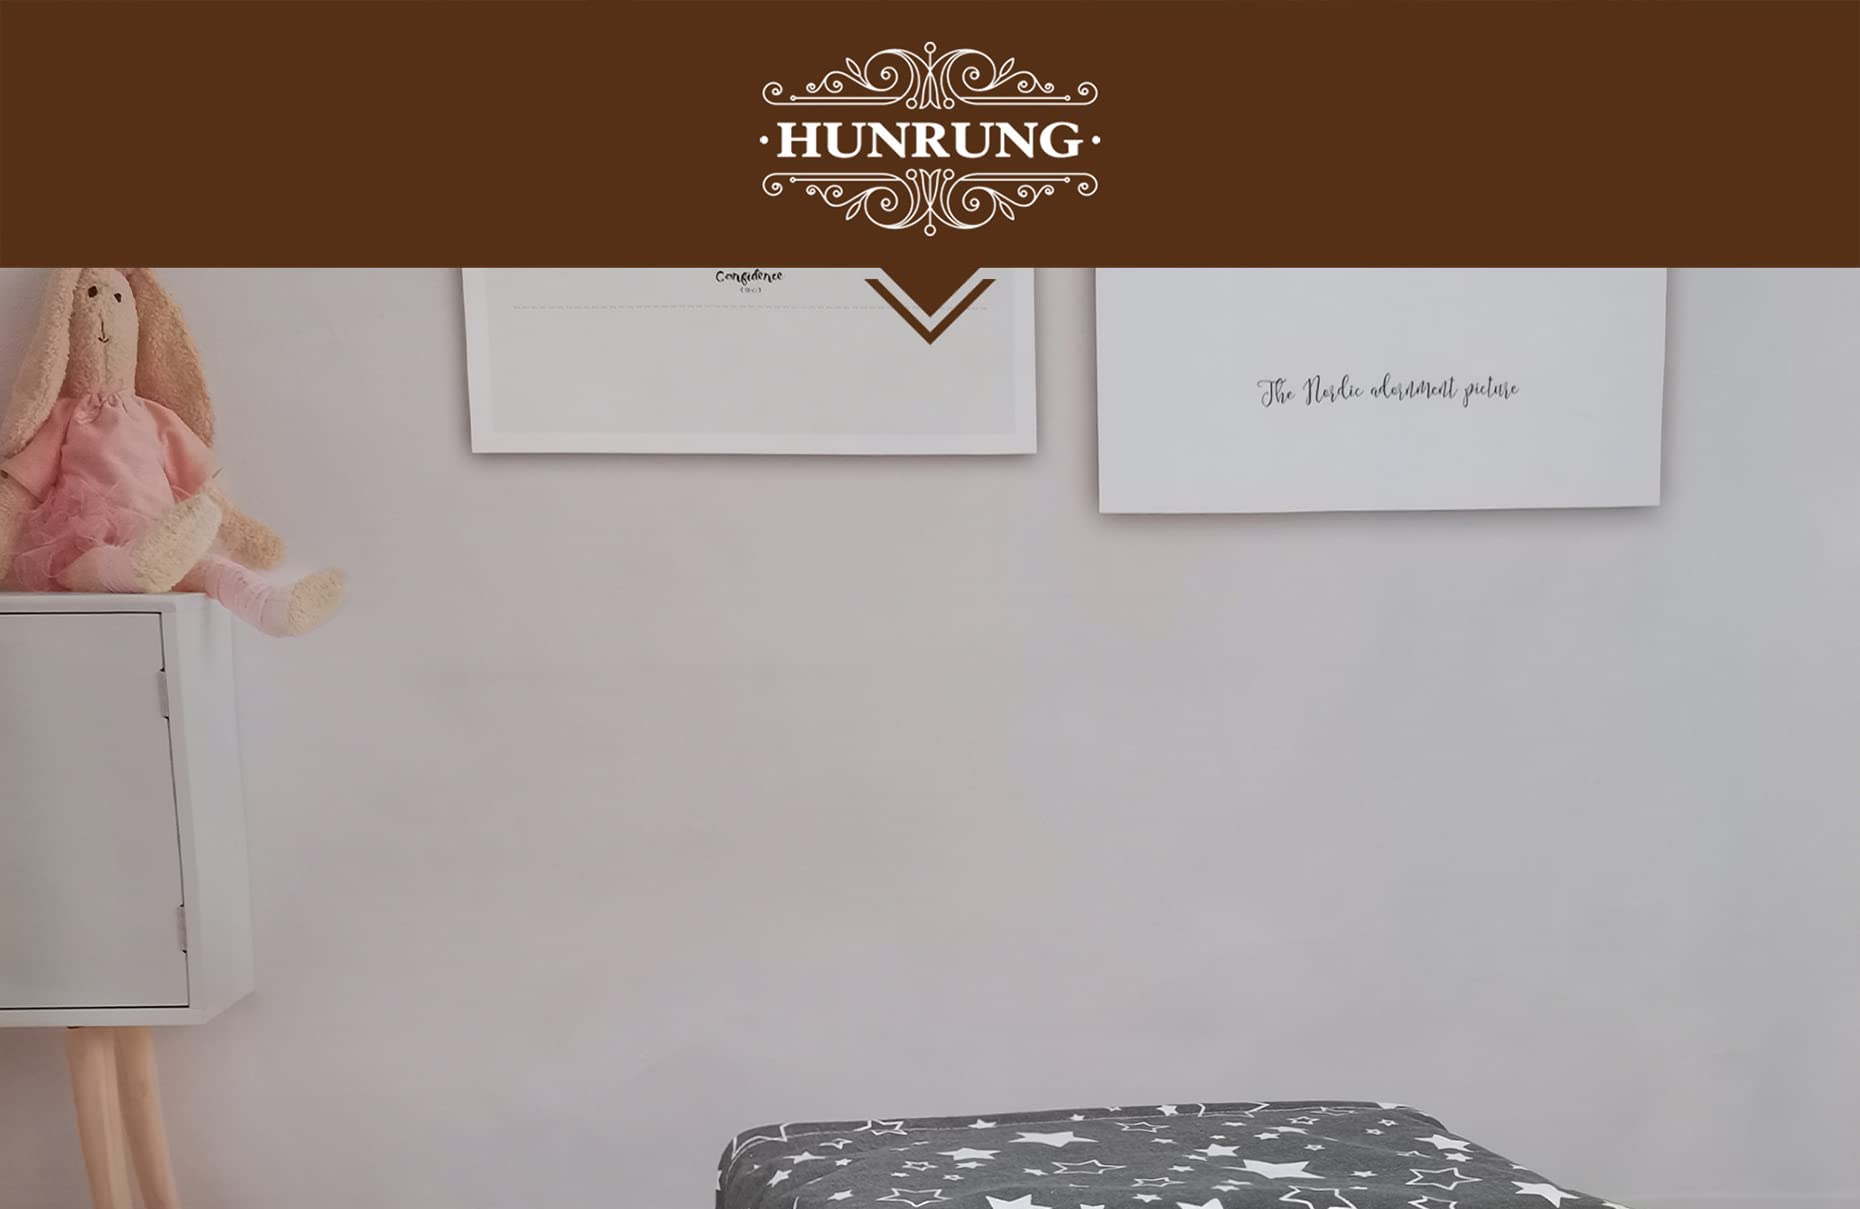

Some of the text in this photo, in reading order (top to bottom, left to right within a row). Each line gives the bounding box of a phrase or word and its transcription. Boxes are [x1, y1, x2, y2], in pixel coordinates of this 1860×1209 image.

[1257, 377, 1296, 408] The
[1303, 374, 1364, 406] Nordic
[1463, 375, 1520, 408] picture
